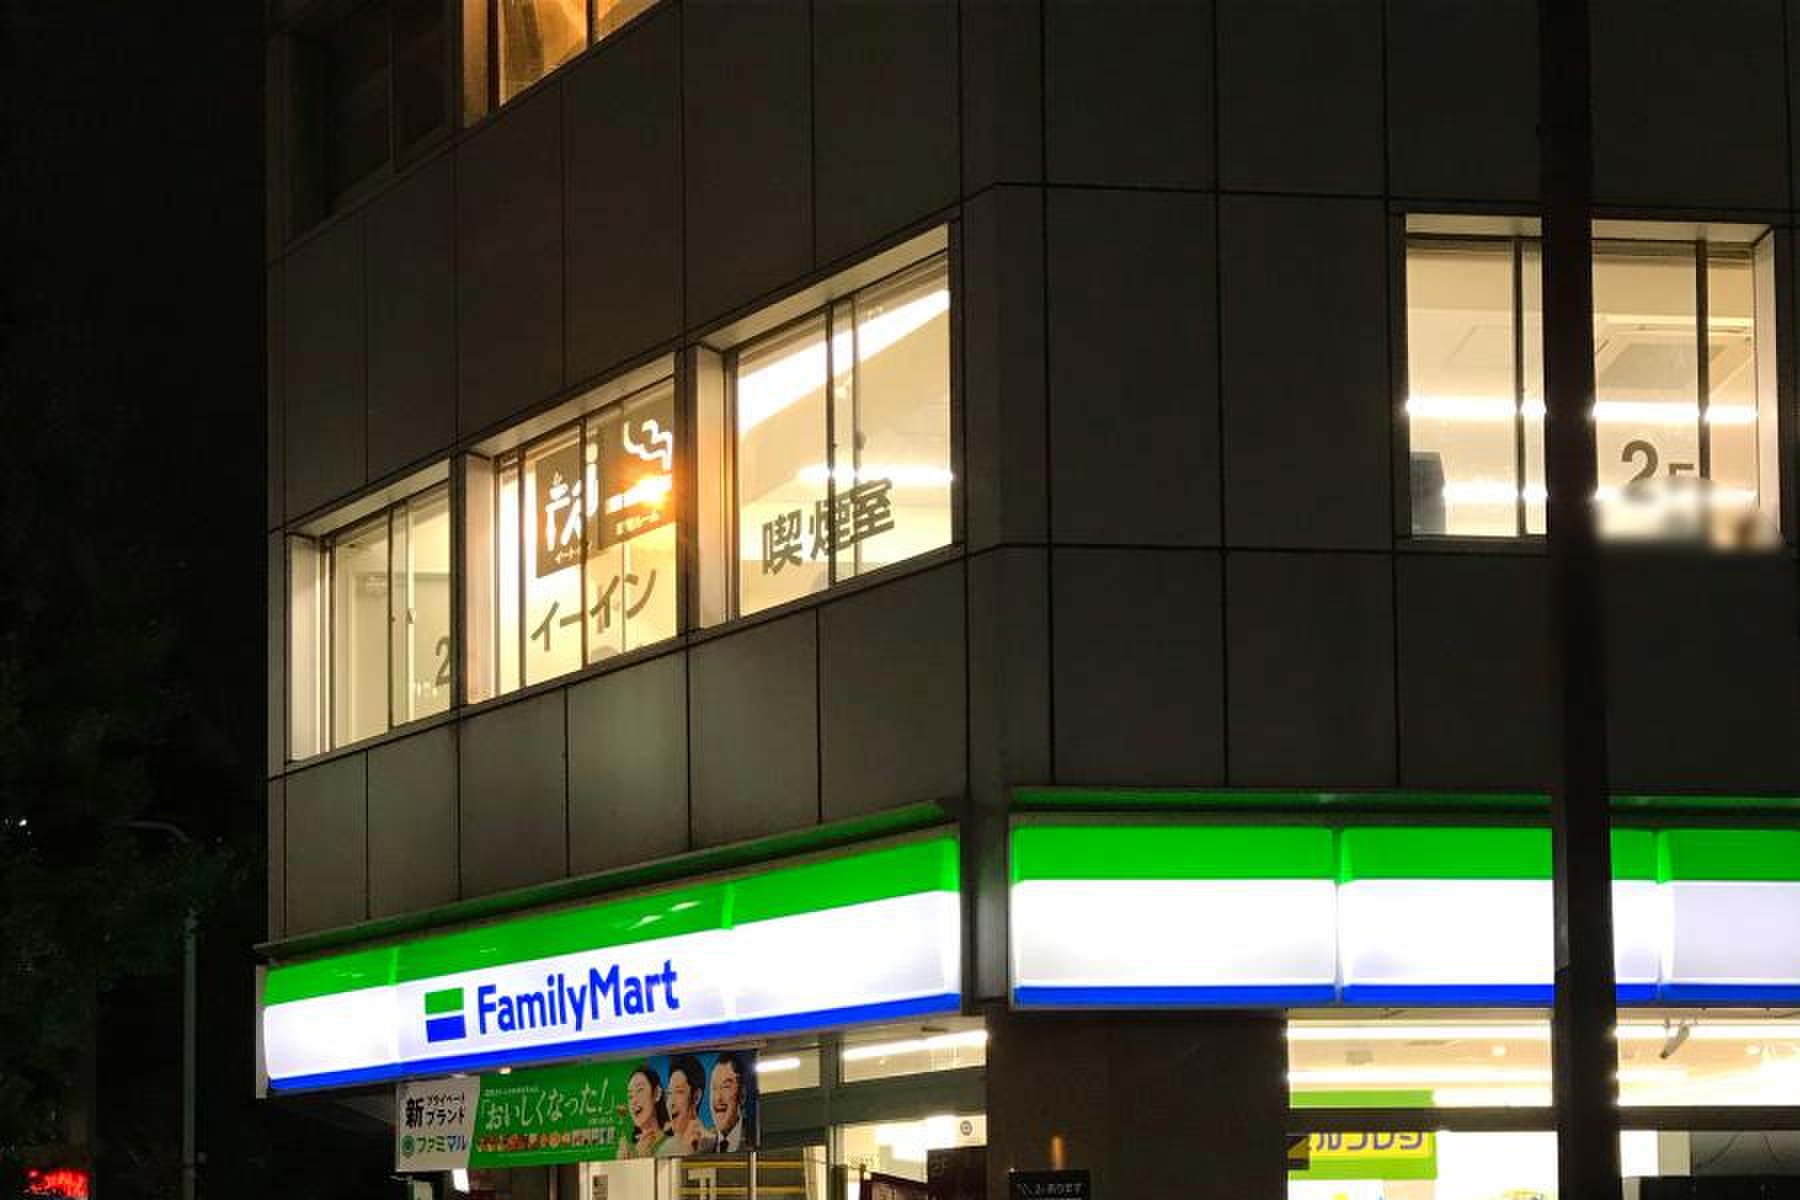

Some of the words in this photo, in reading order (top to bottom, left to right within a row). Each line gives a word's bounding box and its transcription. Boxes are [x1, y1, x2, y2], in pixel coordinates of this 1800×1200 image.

[762, 479, 895, 575] 喫煙室
[477, 959, 680, 1035] FamilyMart
[405, 1097, 424, 1129] 新
[416, 1135, 466, 1153] ファミマル
[1290, 1131, 1423, 1151] ルフレジ
